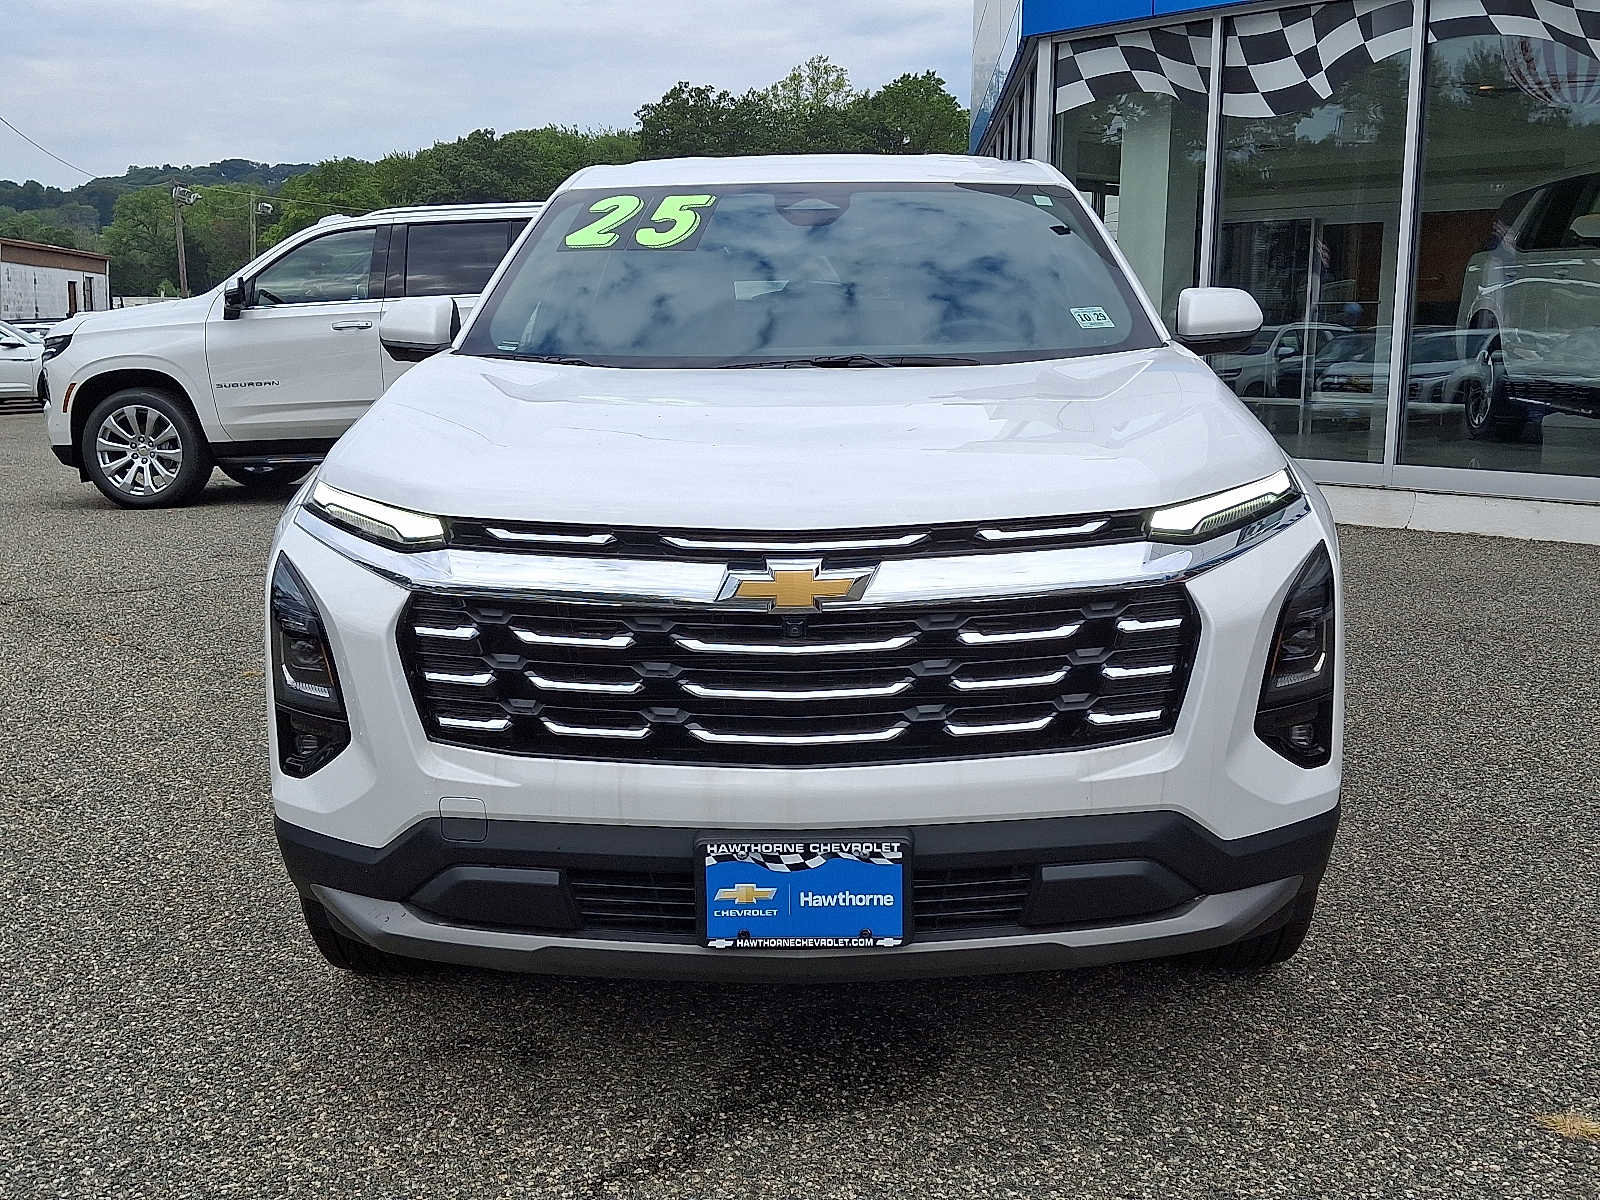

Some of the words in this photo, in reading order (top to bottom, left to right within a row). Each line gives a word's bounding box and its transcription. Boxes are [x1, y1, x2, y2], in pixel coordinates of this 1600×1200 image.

[564, 194, 717, 249] 25
[1077, 313, 1092, 322] 10
[1093, 312, 1107, 321] 29
[215, 380, 280, 389] SUBURBAN
[706, 843, 805, 854] HAWTHORNE
[809, 842, 901, 853] CHEVROLET
[799, 890, 895, 907] Hawthorne
[713, 909, 779, 917] CHEVROLET
[736, 938, 874, 948] HAWTHORNECHEVROLET.COM
